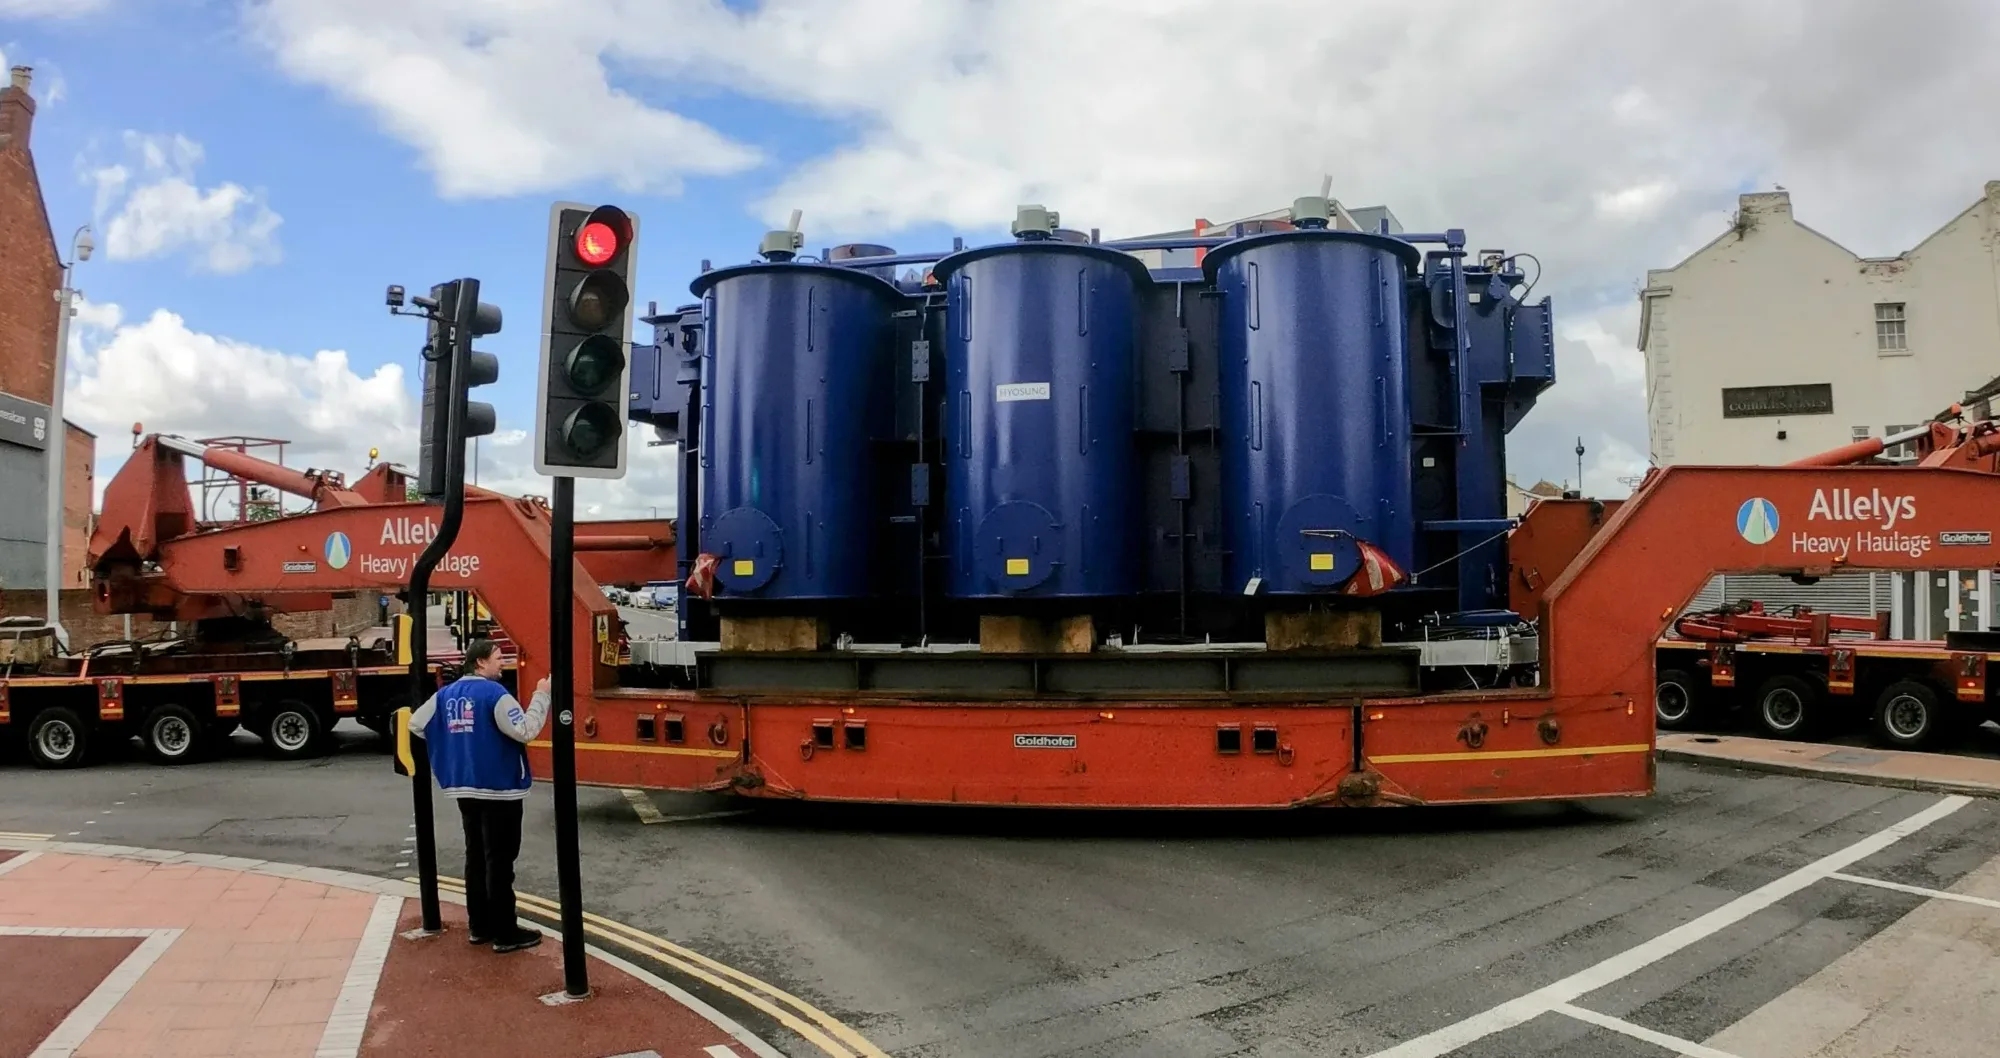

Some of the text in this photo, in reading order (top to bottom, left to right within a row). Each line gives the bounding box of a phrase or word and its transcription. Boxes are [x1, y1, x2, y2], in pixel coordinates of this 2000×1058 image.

[999, 387, 1046, 397] HYOSUNG
[1807, 488, 1916, 530] Allelys
[1792, 531, 1931, 558] Heavy Haulage
[1942, 533, 1990, 543] Goldhofer
[360, 553, 407, 579] Heavy
[507, 707, 524, 726] 30
[1016, 736, 1074, 746] Goldhofer
